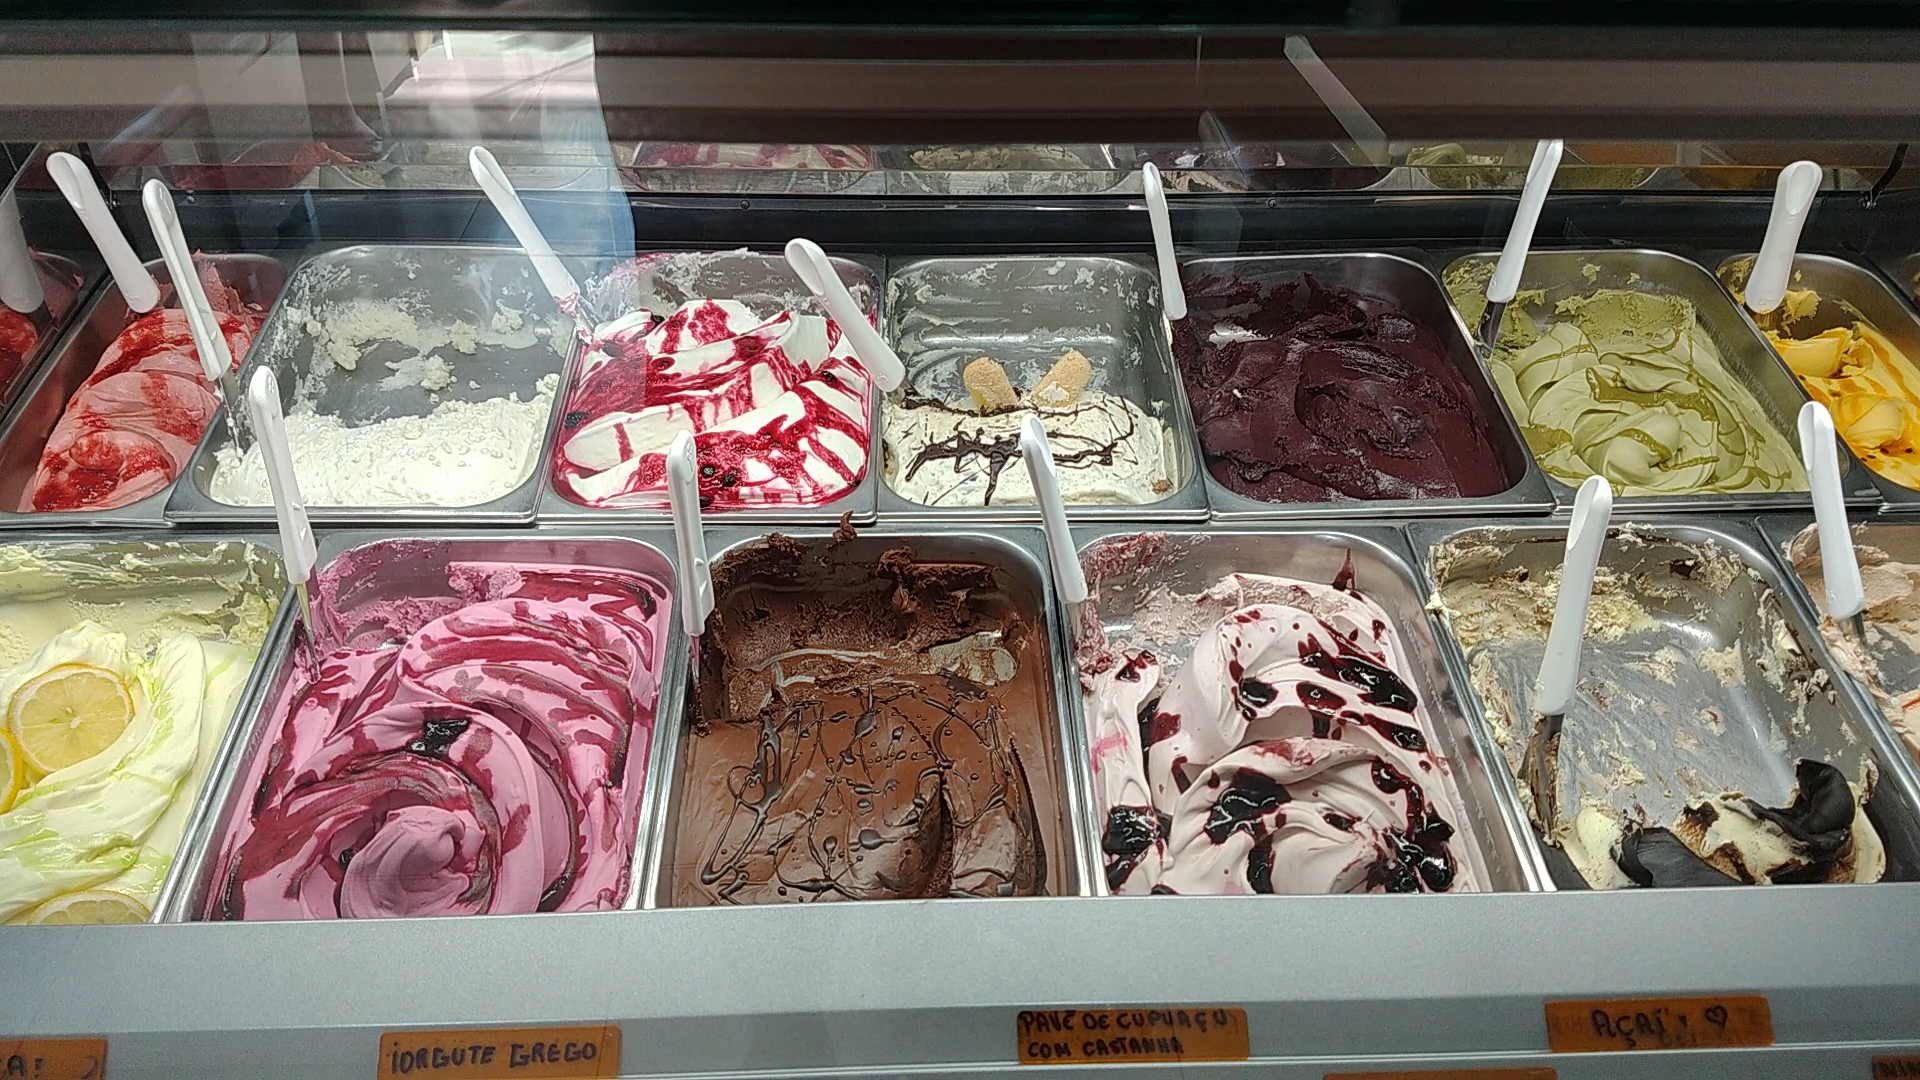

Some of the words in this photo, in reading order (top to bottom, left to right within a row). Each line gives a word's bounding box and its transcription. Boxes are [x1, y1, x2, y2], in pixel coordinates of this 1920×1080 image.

[1083, 1013, 1109, 1030] DE
[509, 1041, 597, 1068] GREGO
[1027, 1041, 1071, 1058] COM
[1082, 1037, 1184, 1057] CASTANHA
